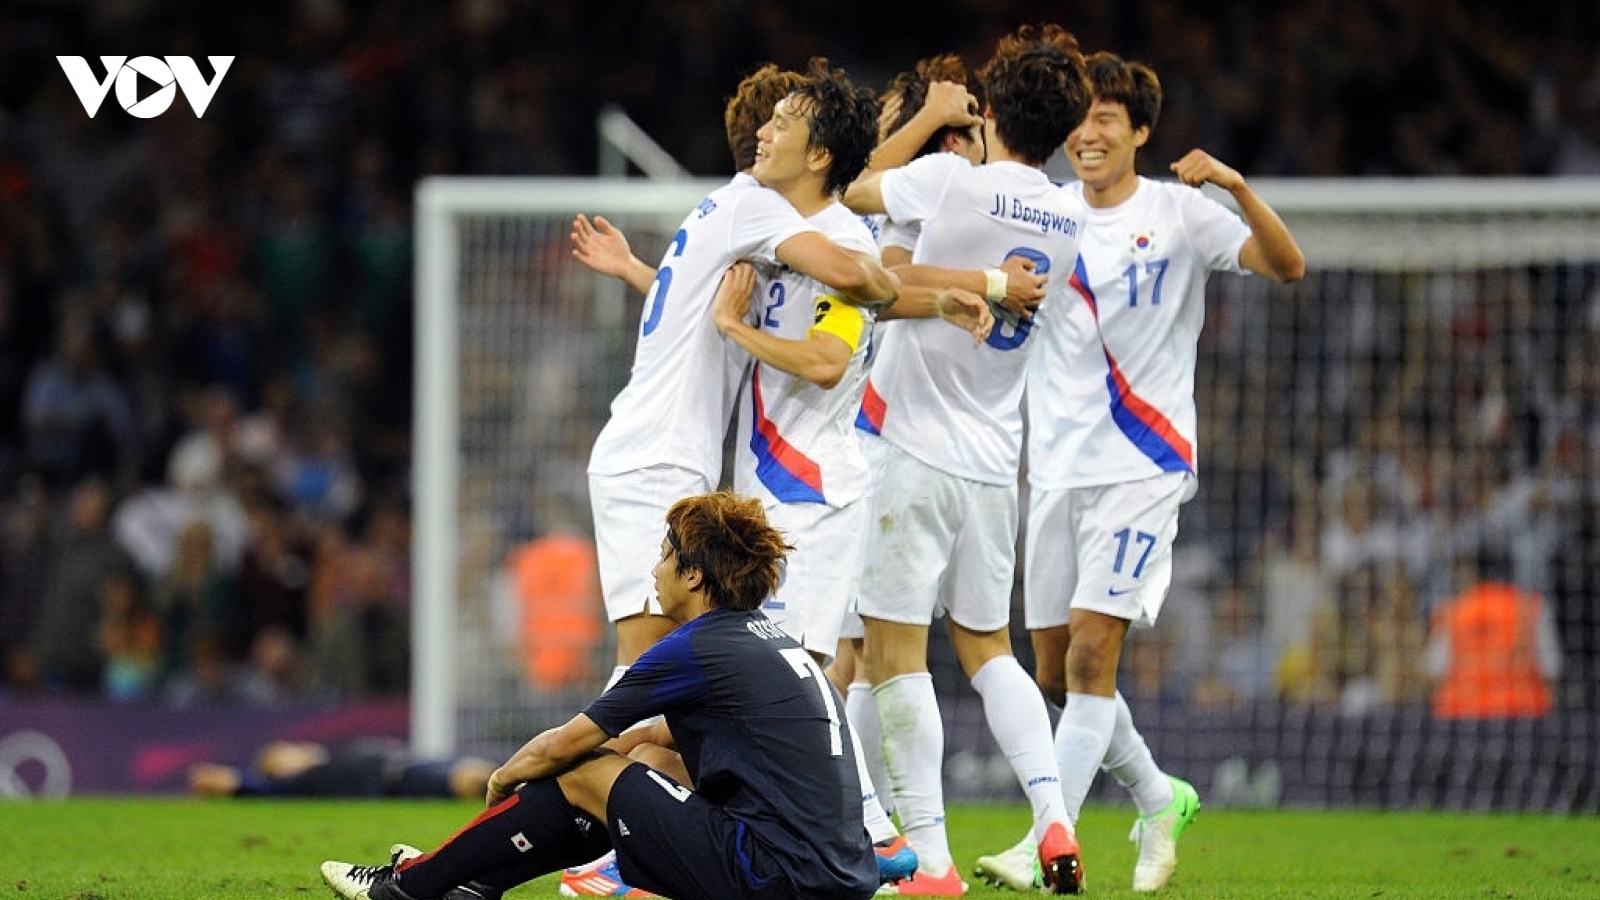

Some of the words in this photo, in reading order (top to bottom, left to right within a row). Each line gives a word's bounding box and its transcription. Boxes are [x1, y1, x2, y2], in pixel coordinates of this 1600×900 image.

[1012, 198, 1077, 239] Dongwon
[1122, 259, 1170, 308] 17
[1112, 526, 1157, 579] 17
[777, 647, 843, 756] 7
